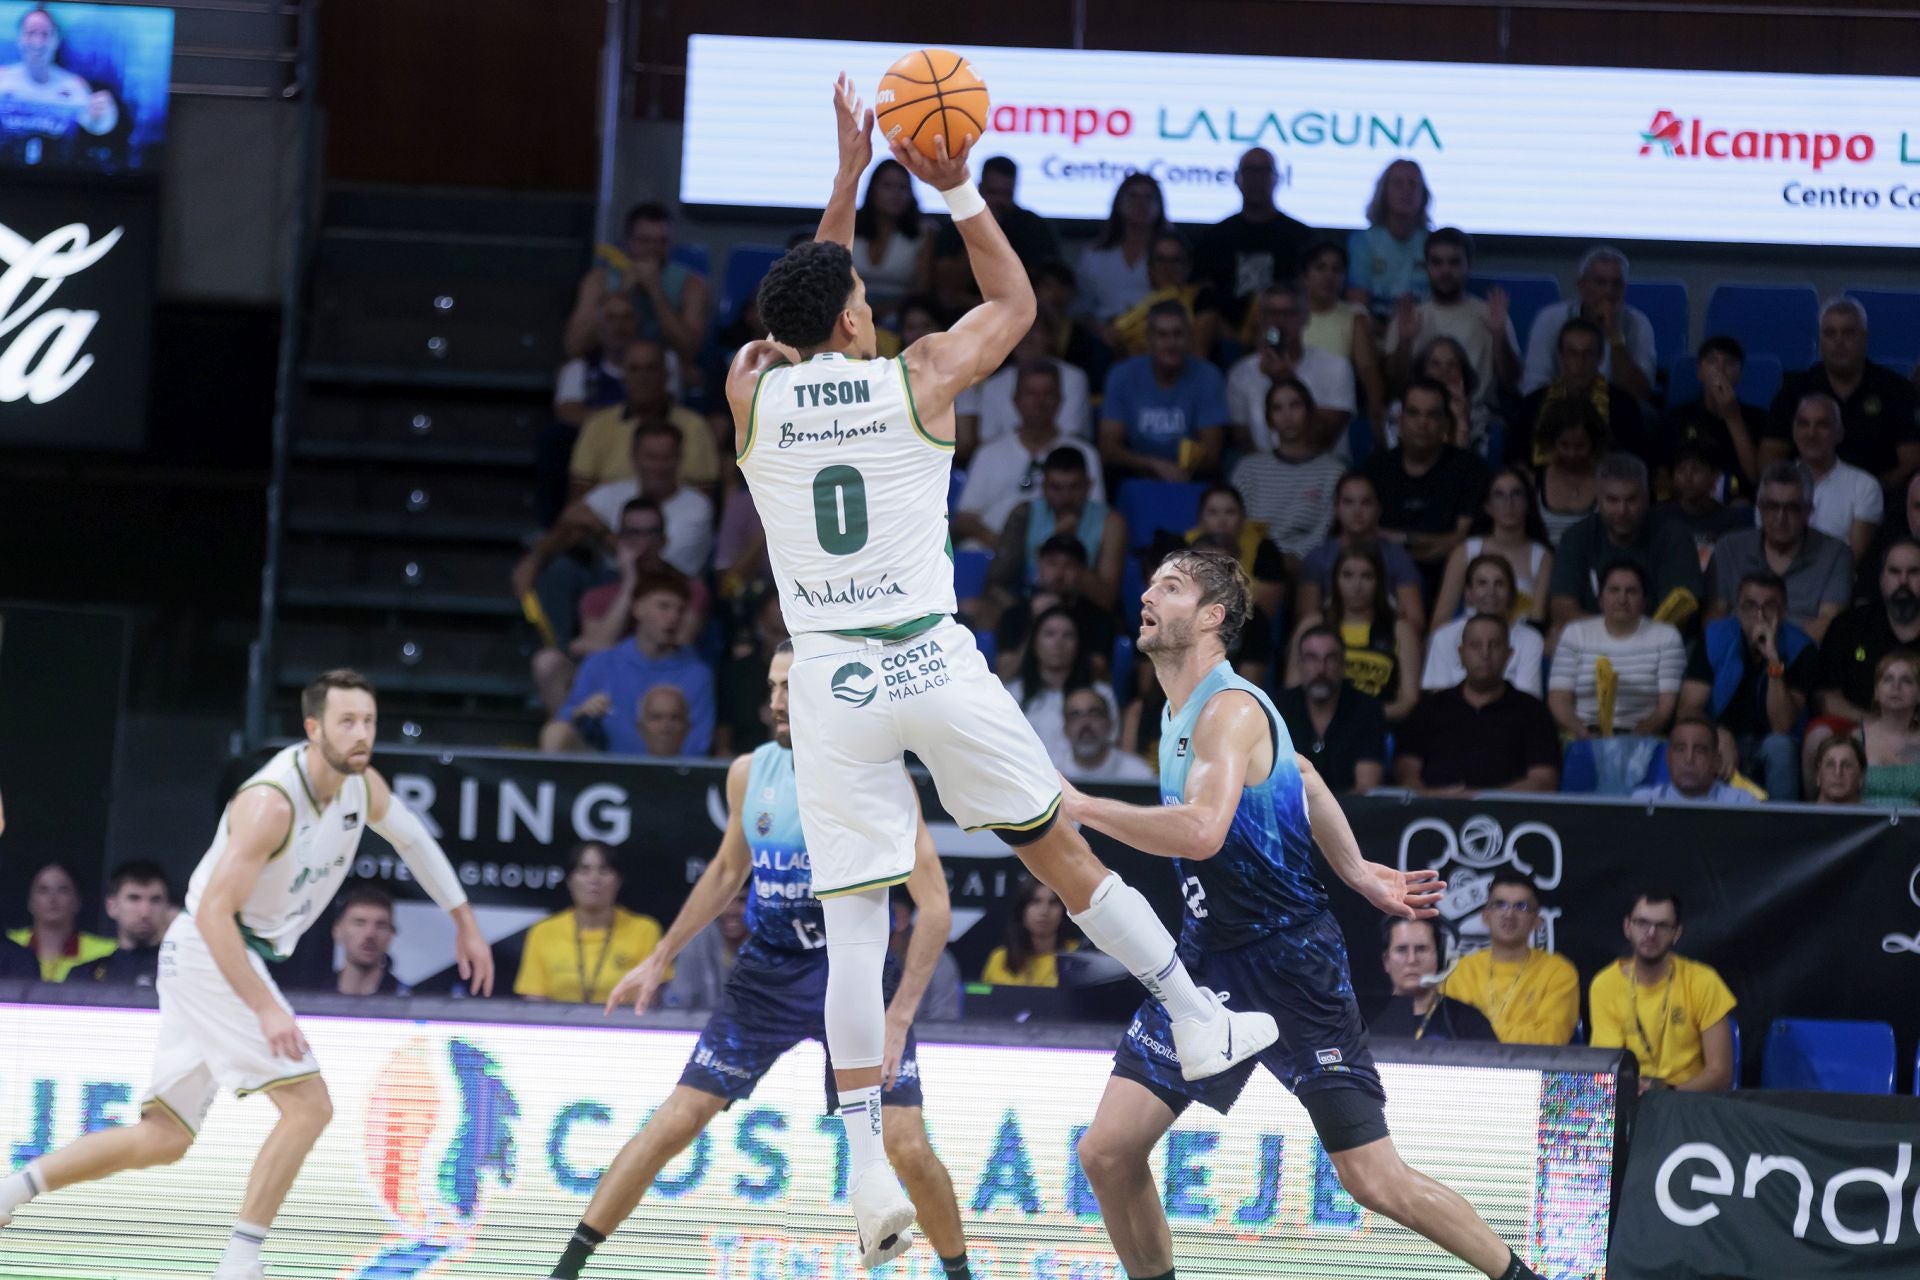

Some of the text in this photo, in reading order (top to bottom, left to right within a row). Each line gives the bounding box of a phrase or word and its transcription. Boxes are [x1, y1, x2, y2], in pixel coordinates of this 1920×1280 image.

[992, 104, 1443, 150] ampo LALAGUNA
[1639, 110, 1875, 170] Alcampo
[1149, 158, 1293, 188] Comel
[1782, 181, 1880, 208] Centro
[794, 380, 871, 408] TYSON
[812, 464, 869, 556] 0
[881, 640, 944, 671] COSTA
[884, 657, 947, 687] DEL SOL
[888, 672, 953, 702] MÁLAGA
[393, 774, 632, 847] RING
[353, 854, 413, 882] OTE
[459, 860, 566, 889] GROUP
[751, 848, 812, 872] LA LAG
[753, 875, 815, 901] teneri
[1137, 1031, 1181, 1064] Hospite
[869, 1098, 881, 1137] UNICAJA
[546, 1098, 852, 1204] COST
[1654, 1142, 1920, 1245] end
